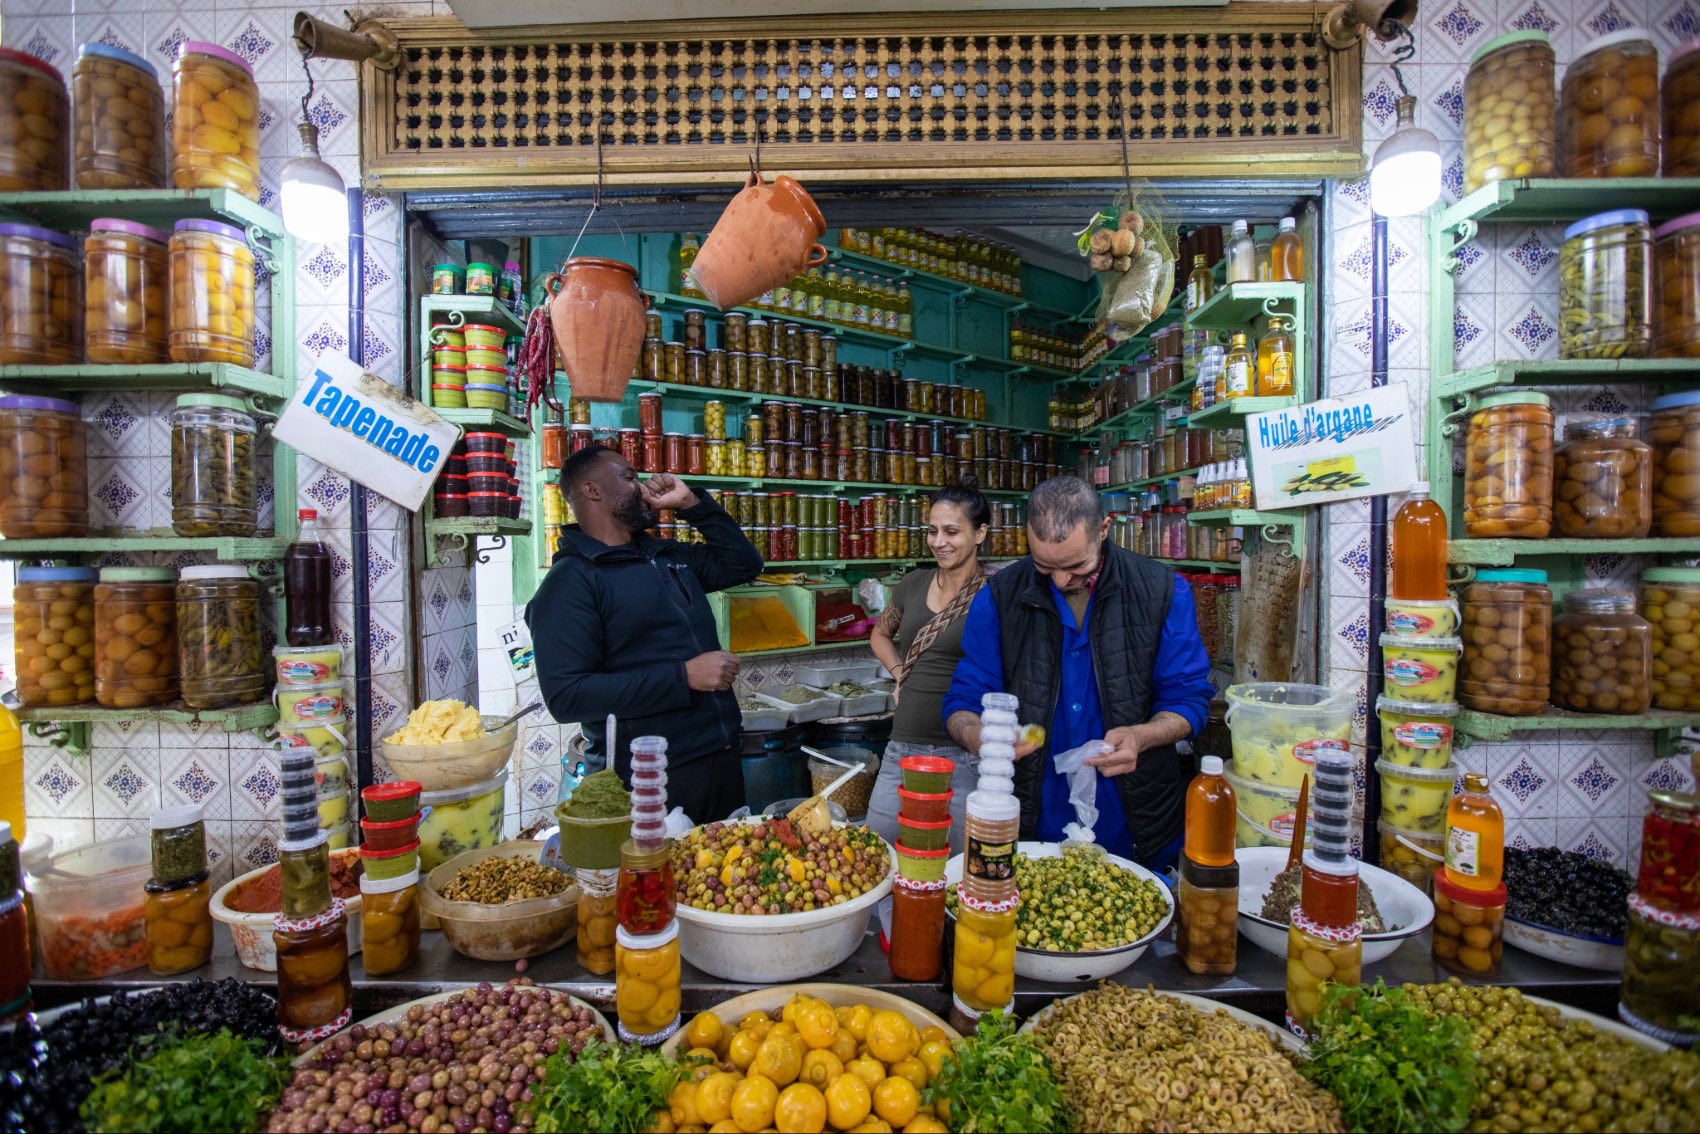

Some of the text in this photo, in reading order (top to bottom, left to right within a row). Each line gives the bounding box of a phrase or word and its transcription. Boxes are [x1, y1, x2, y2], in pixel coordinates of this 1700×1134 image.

[303, 368, 440, 474] Tapenade
[1258, 403, 1373, 449] Huile d'argane
